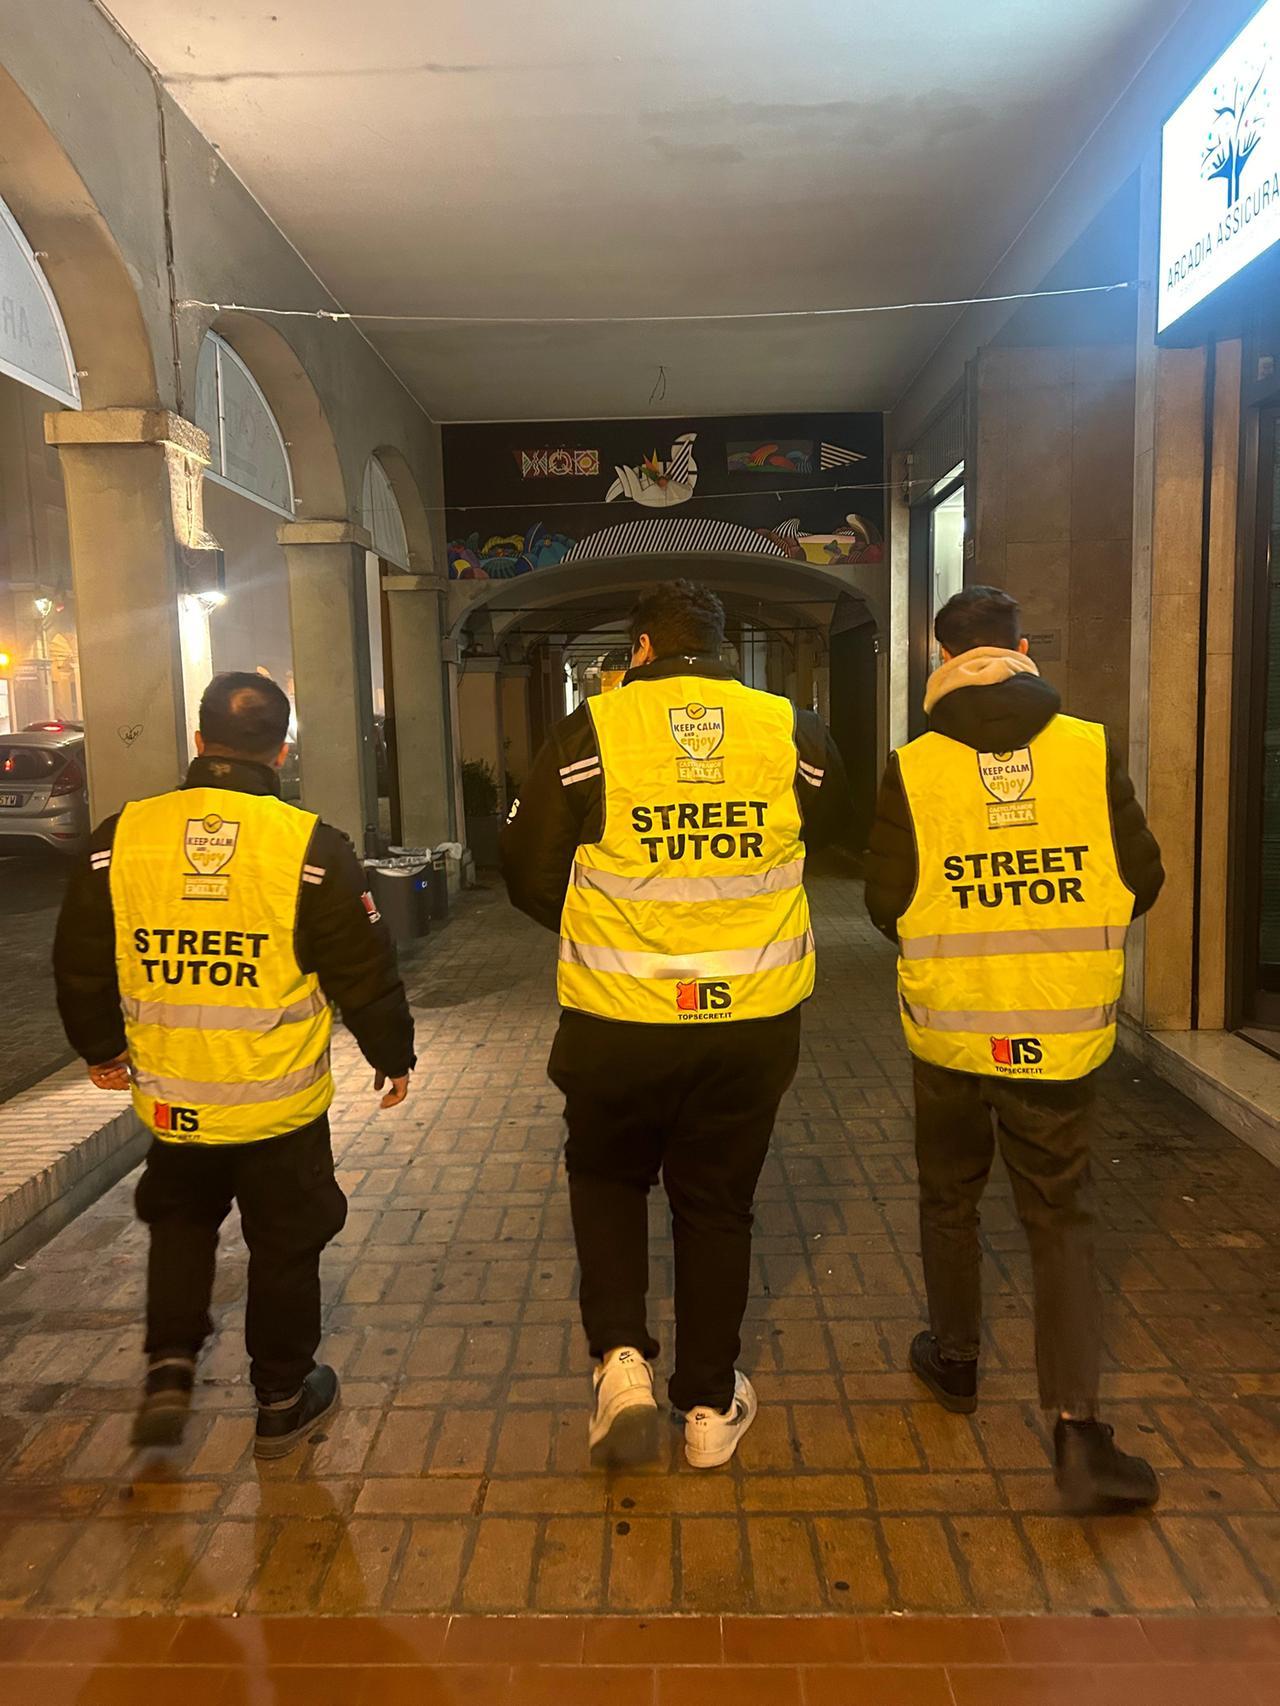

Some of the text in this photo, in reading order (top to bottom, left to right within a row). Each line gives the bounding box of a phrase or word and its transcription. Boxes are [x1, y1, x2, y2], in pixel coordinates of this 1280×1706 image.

[1167, 231, 1212, 292] ARCADIA
[674, 721, 720, 733] KEEP CALM
[680, 734, 716, 752] enjoy
[983, 763, 1030, 776] KEEP CALM
[990, 778, 1025, 794] enjoy
[632, 801, 768, 833] STREET
[187, 837, 233, 847] KEEP CALM
[640, 832, 763, 863] TUTOR
[944, 846, 1089, 881] STREET
[952, 877, 1085, 909] TUTOR
[134, 928, 269, 958] STREET
[141, 959, 260, 988] TUTOR
[678, 1012, 732, 1020] TOPSECRET.IT
[996, 1066, 1043, 1074] TOPSECRET.IT
